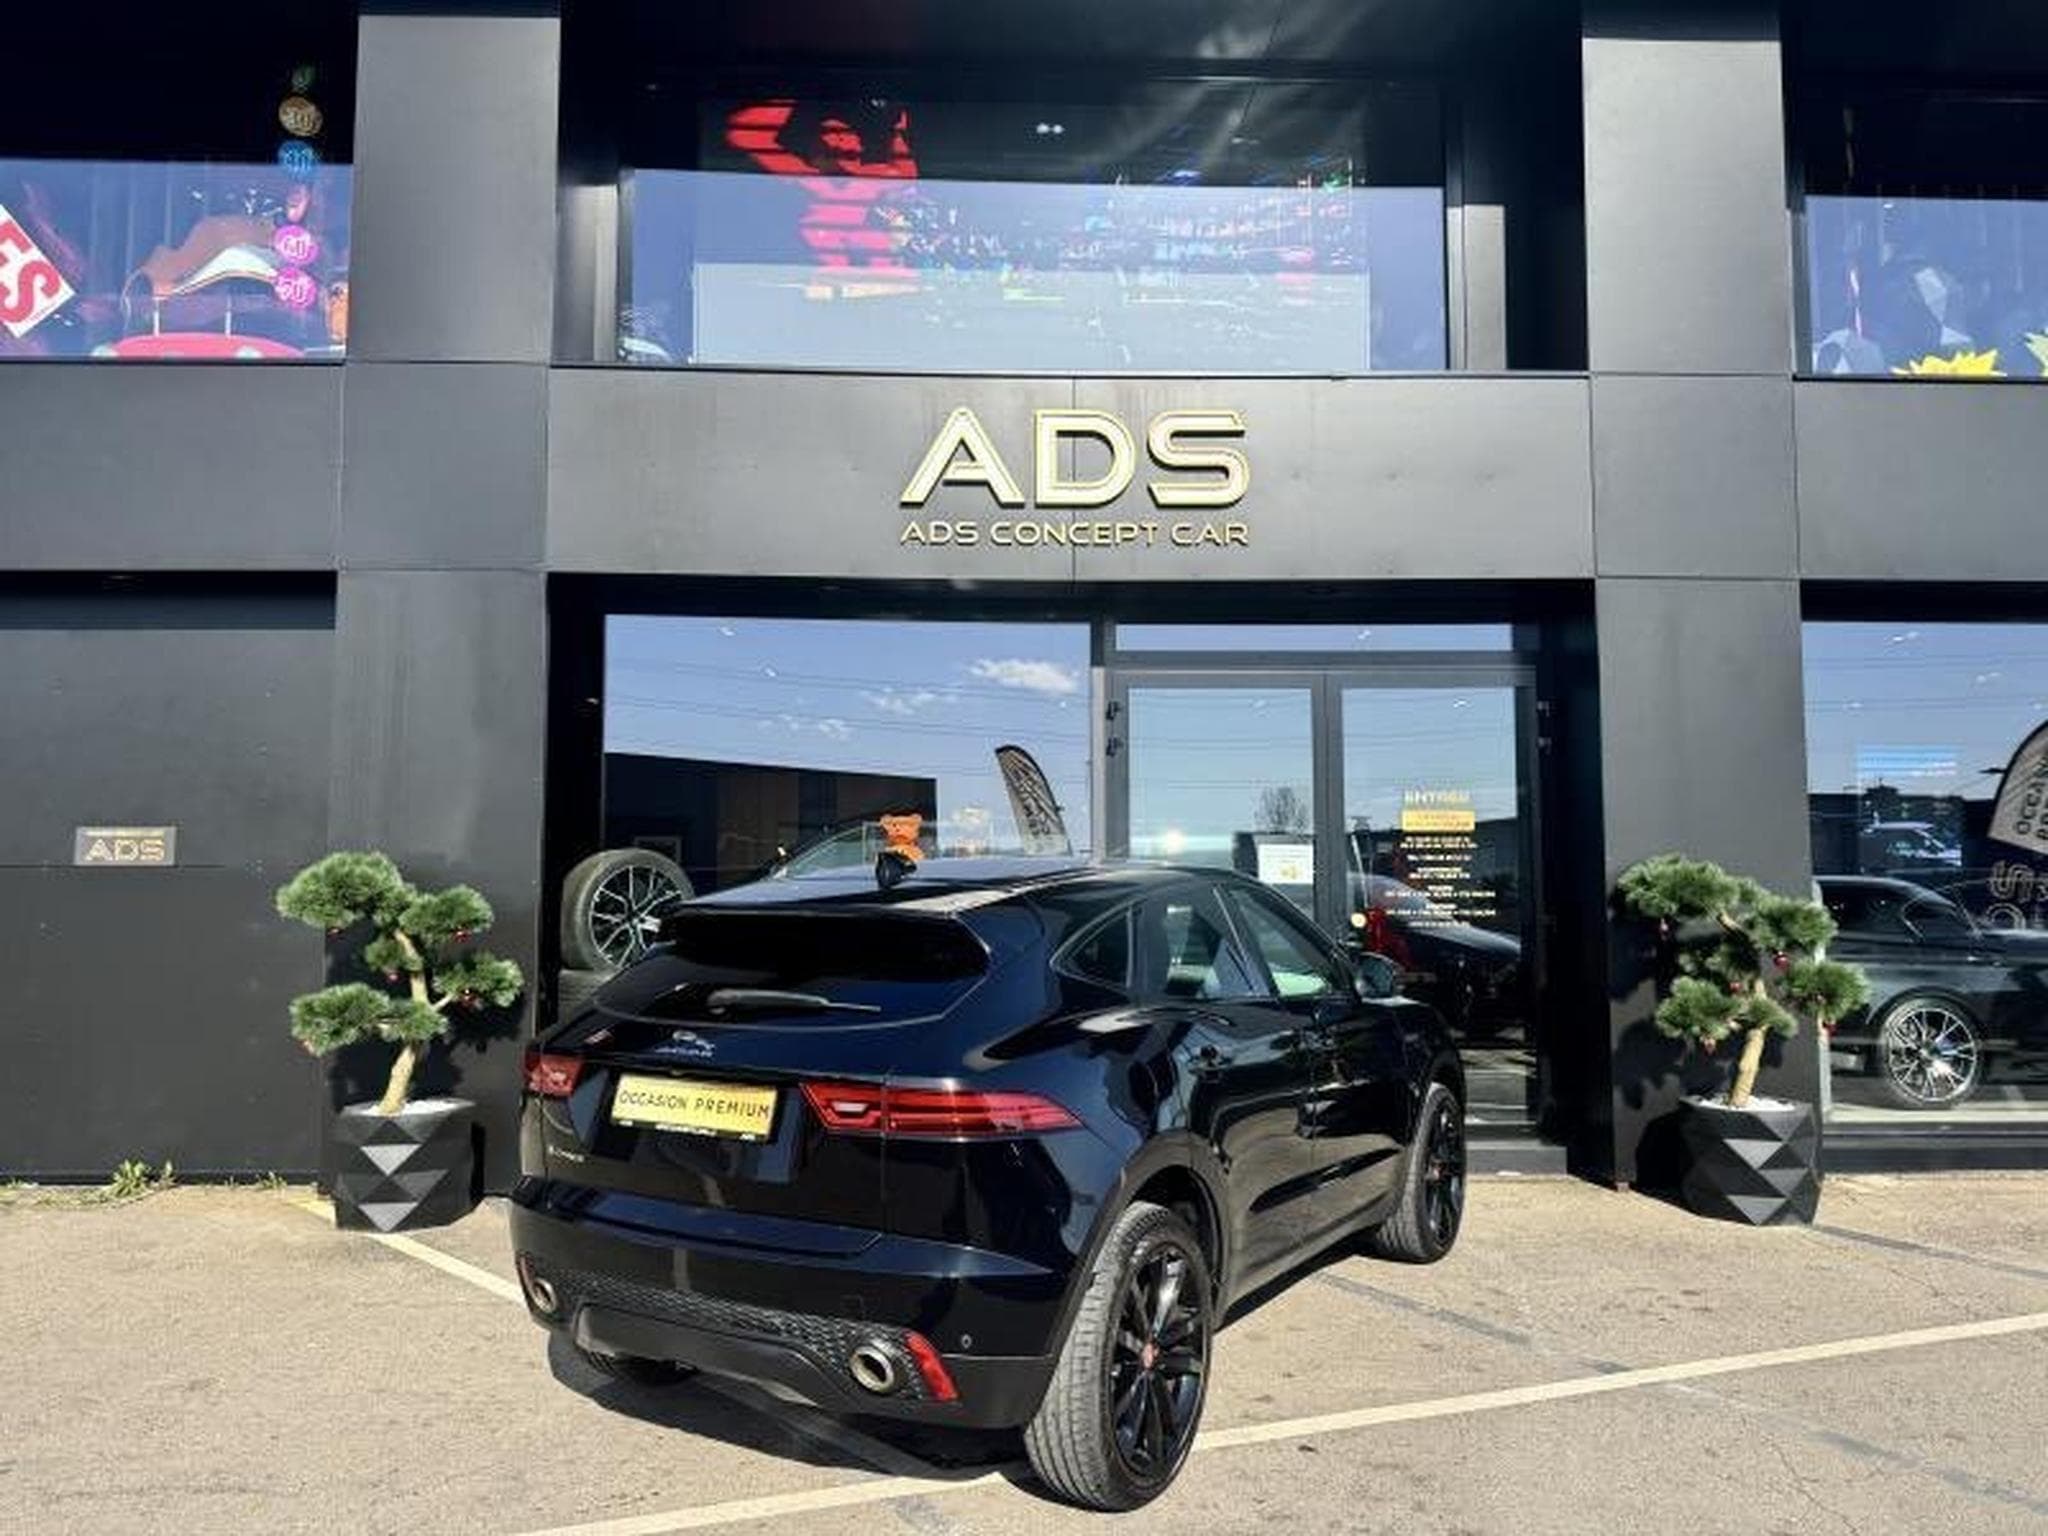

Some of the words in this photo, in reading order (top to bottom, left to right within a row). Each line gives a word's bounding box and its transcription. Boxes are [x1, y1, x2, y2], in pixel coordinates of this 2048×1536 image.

[900, 406, 1250, 509] ADS
[900, 520, 979, 545] ADS
[990, 520, 1158, 546] CONCEPT
[1171, 521, 1248, 546] CAR
[85, 838, 165, 861] ADS
[619, 1090, 687, 1110] OCCASION
[694, 1097, 770, 1119] PREMIUM
